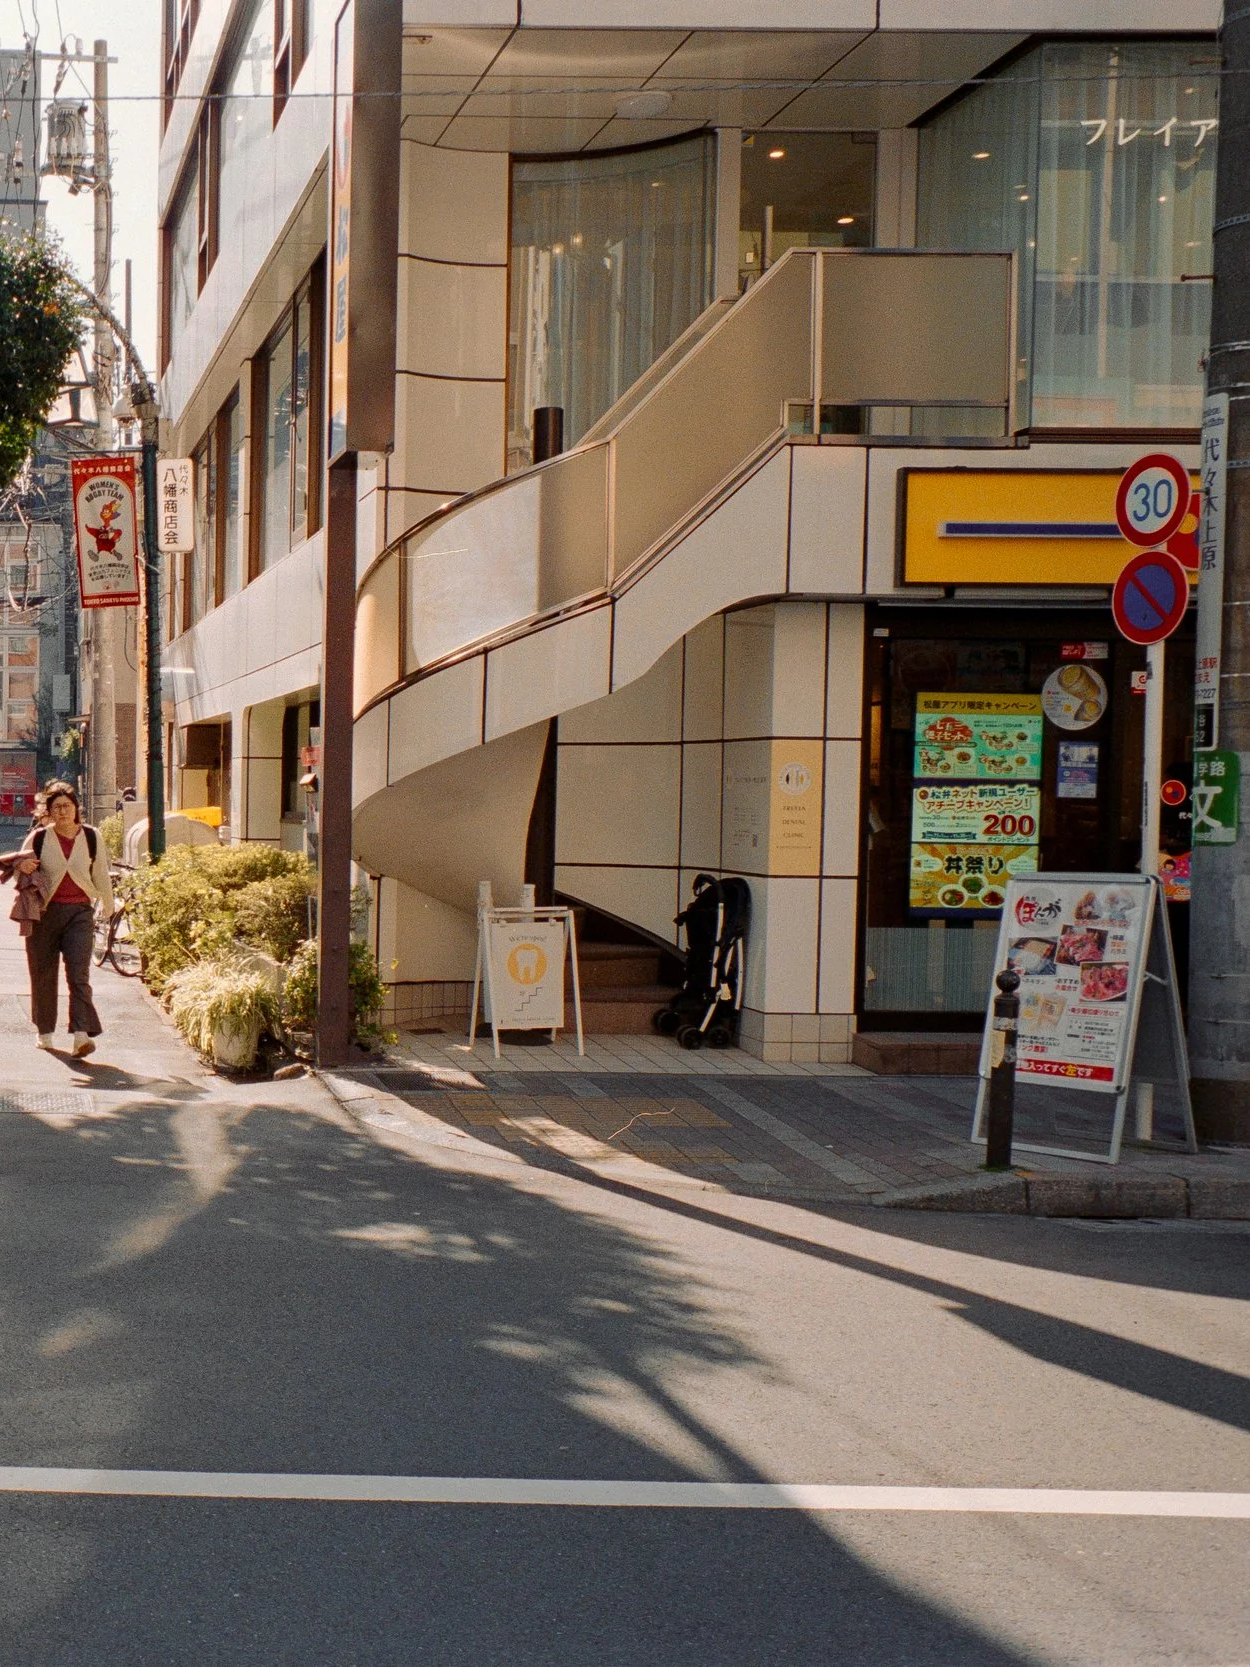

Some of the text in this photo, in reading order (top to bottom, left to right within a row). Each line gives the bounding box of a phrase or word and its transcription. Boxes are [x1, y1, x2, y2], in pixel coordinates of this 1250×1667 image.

[1080, 116, 1219, 147] フレイア
[73, 465, 131, 475] 代々木八幡商店会
[179, 464, 189, 496] 代々木
[85, 490, 125, 503] RUGBY TEAM
[88, 480, 120, 491] WOMEN'S
[163, 468, 178, 545] 八幡商店会
[1133, 478, 1172, 522] 30
[982, 814, 1035, 836] 200
[945, 855, 1004, 875] 丼祭り
